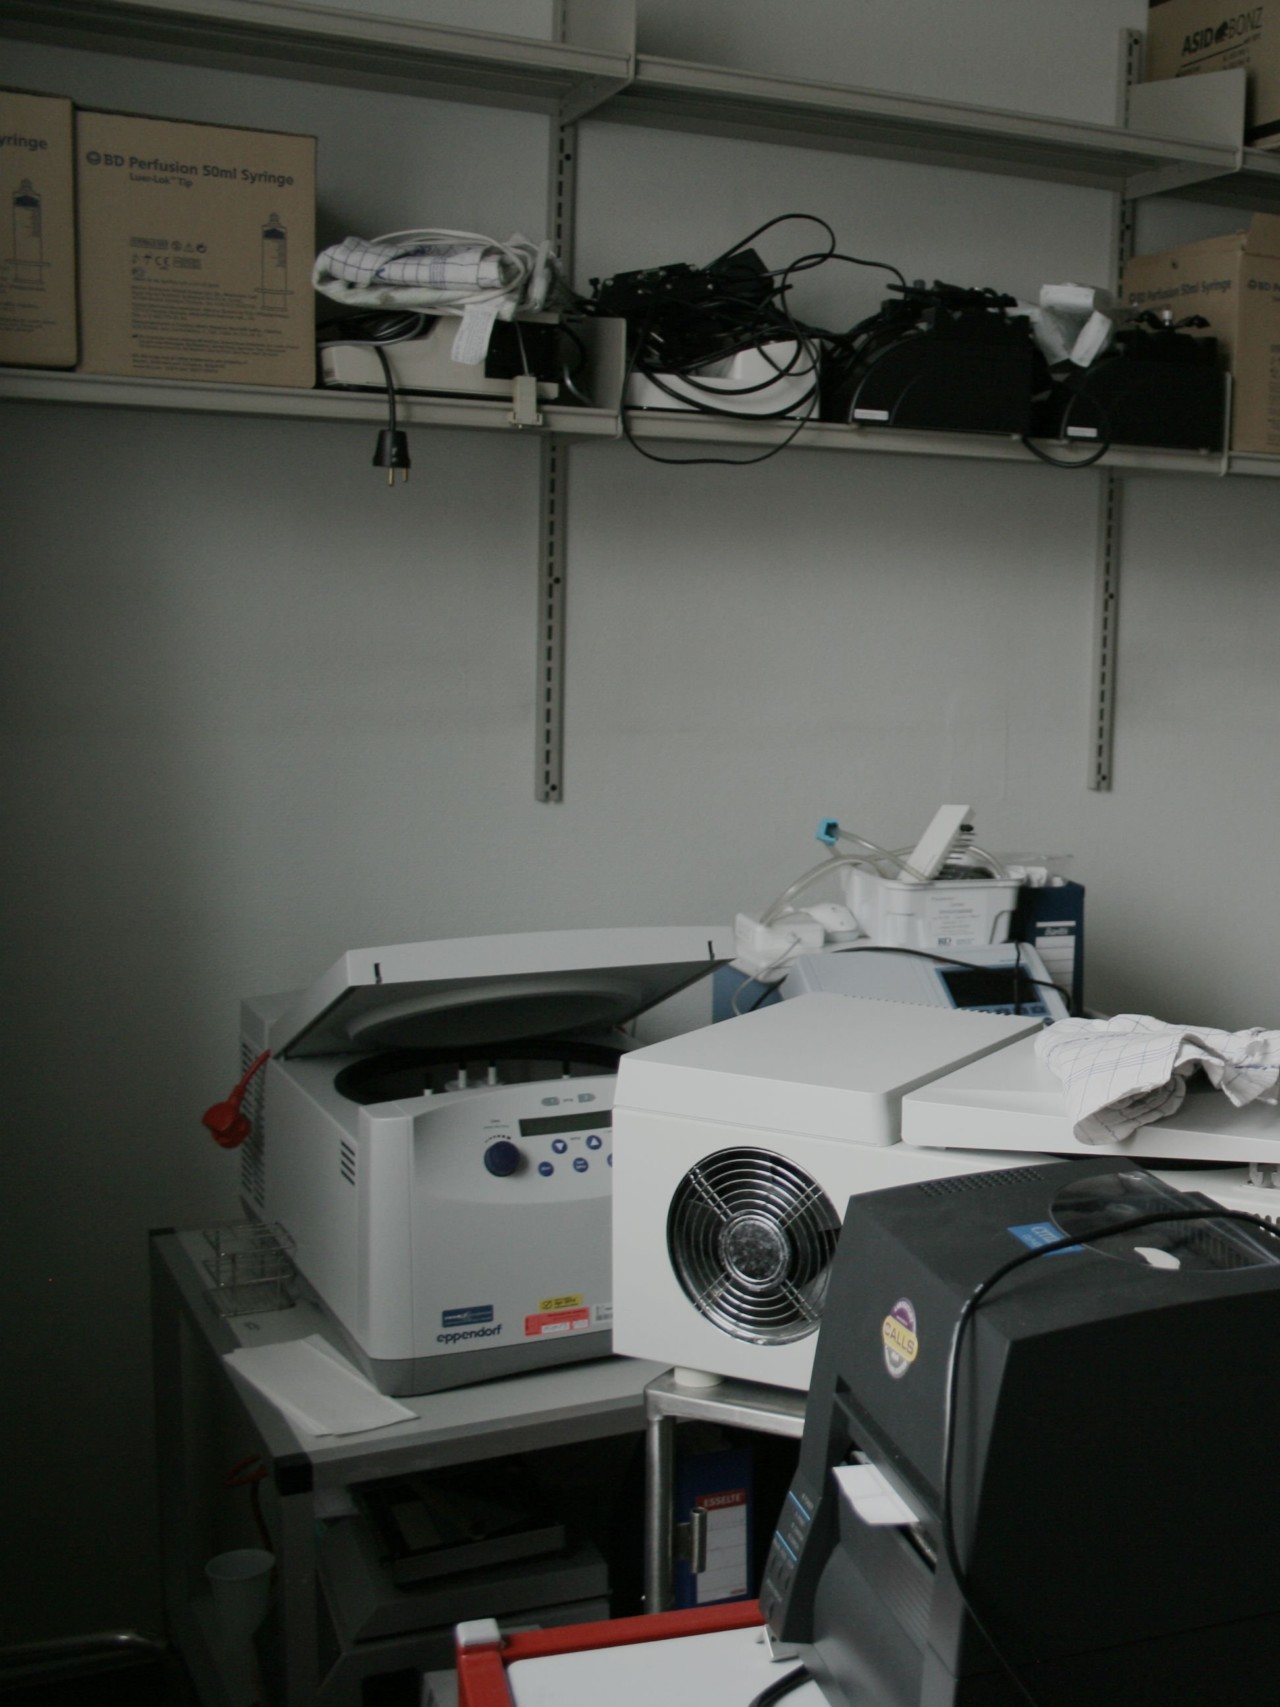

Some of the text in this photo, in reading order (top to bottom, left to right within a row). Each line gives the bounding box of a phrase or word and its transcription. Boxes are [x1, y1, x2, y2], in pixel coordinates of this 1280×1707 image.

[1181, 26, 1214, 57] ASID
[0, 133, 48, 152] yringe
[103, 153, 295, 188] BD Perfusion 50ml Syringe
[436, 1324, 503, 1344] eppendorf
[884, 1321, 915, 1356] CALLS
[703, 1492, 742, 1508] ESSELTE
